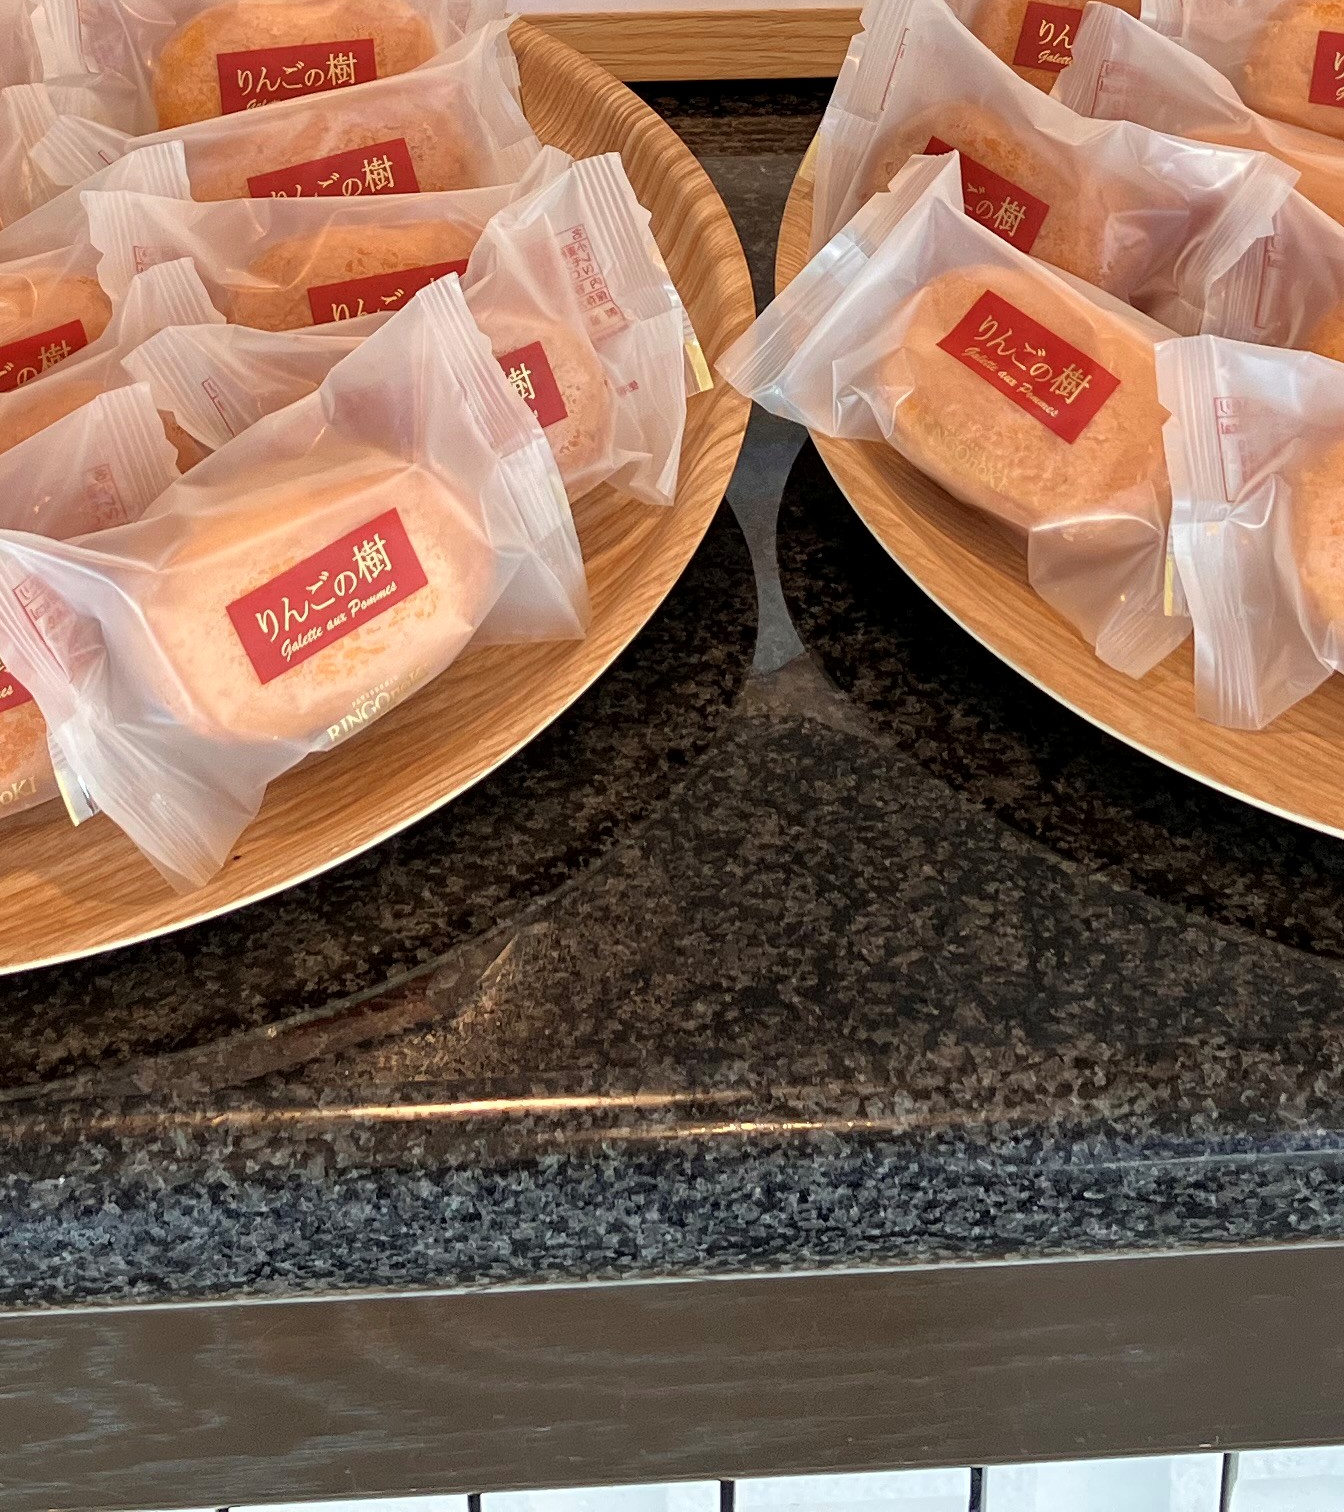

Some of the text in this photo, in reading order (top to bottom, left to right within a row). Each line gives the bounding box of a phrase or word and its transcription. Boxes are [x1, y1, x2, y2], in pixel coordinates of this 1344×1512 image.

[237, 51, 358, 97] りんごの樹
[973, 314, 1092, 405] りんごの樹
[997, 369, 1019, 389] aux
[255, 533, 393, 642] りんごの樹
[281, 580, 398, 662] Galette aux Pommes
